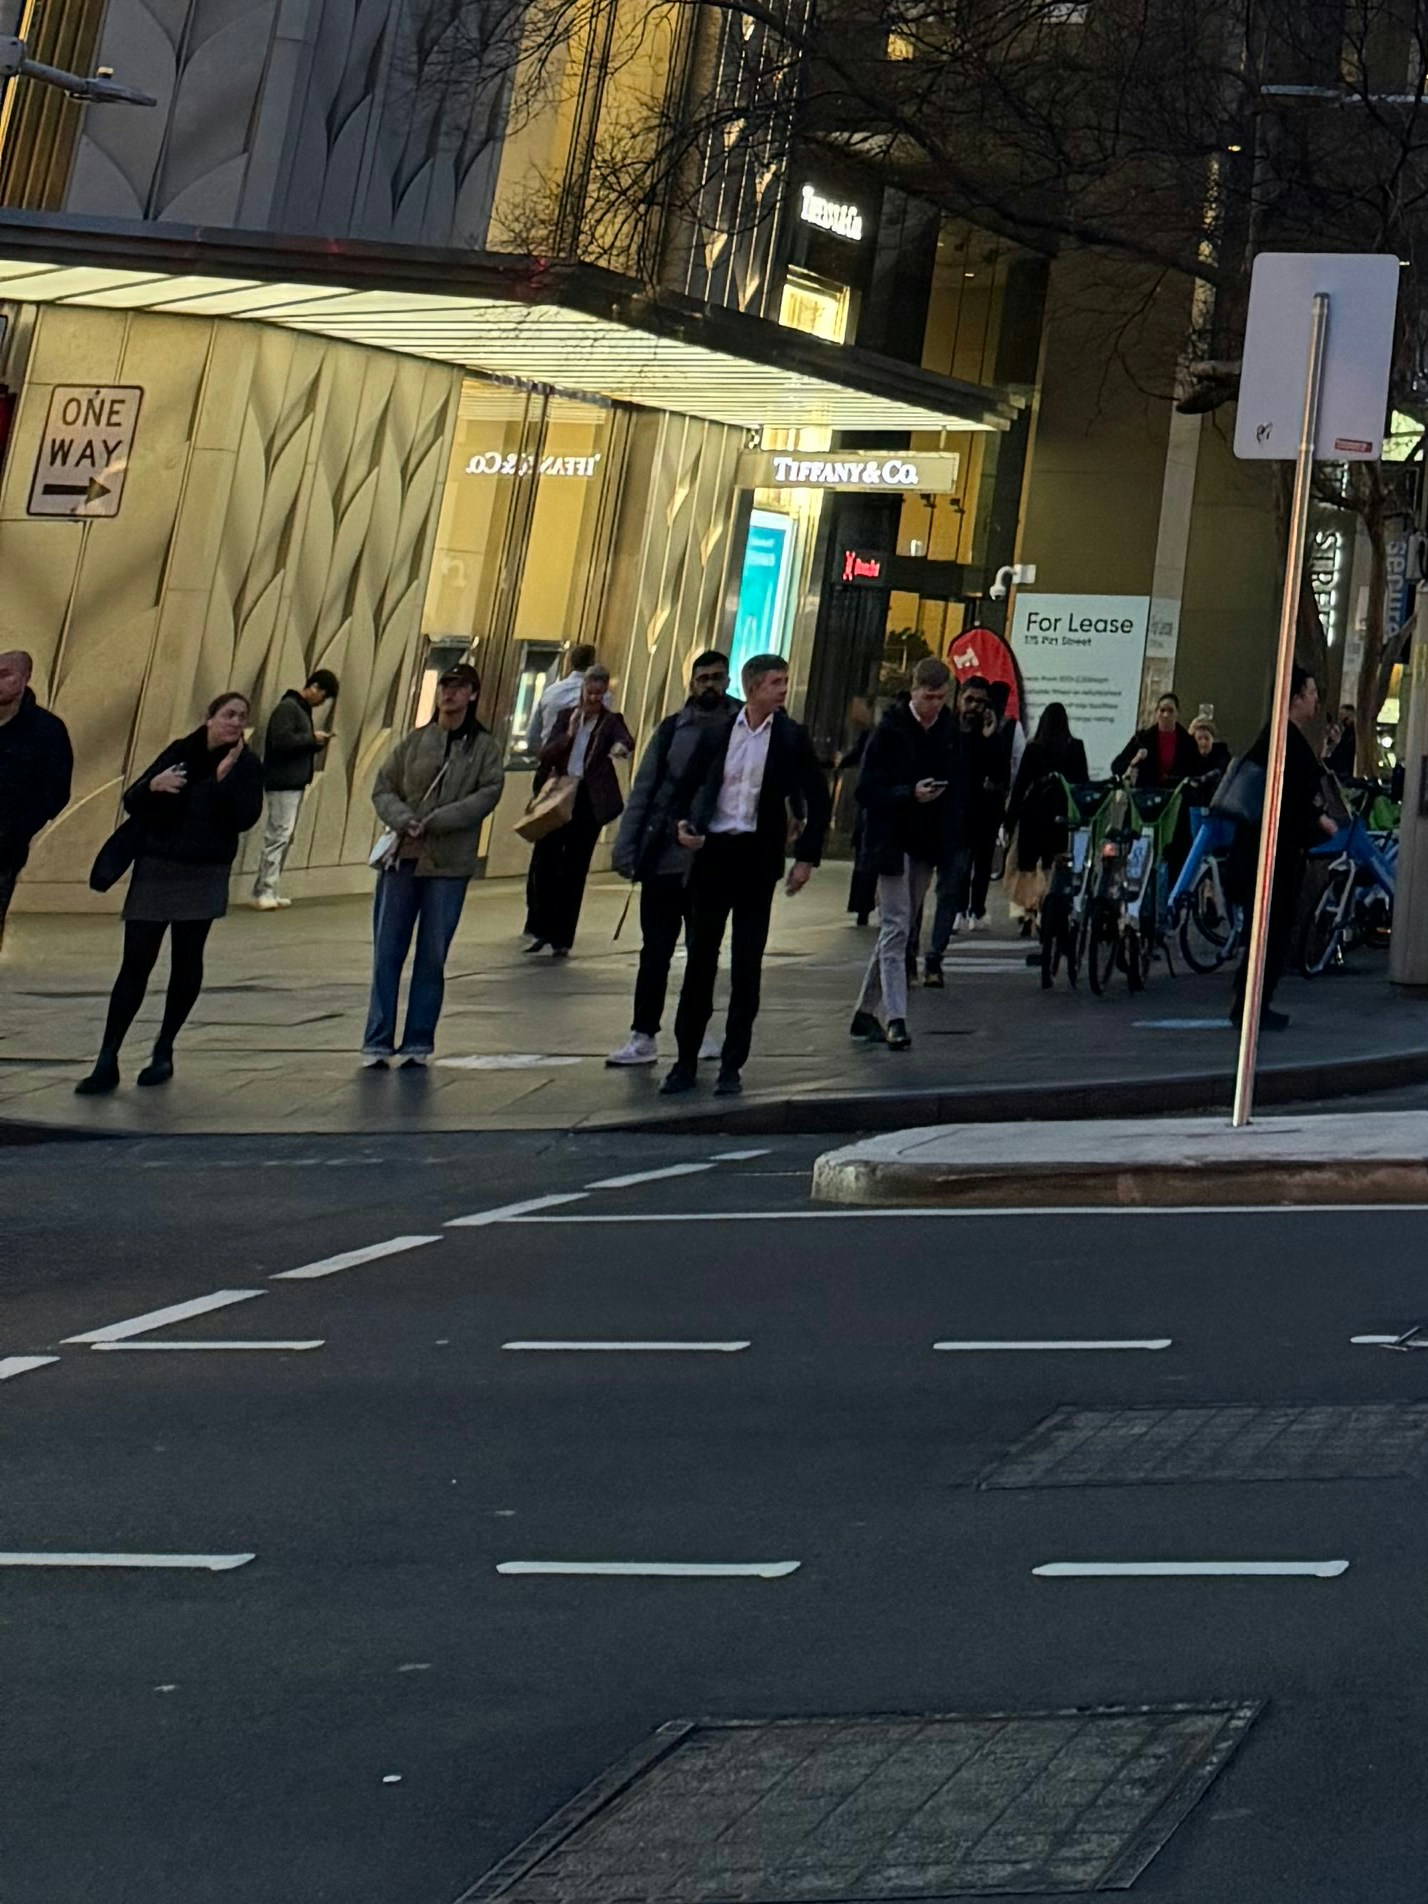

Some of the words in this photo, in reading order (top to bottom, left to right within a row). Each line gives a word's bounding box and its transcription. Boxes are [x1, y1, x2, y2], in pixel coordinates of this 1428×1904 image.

[62, 396, 126, 427] ONE
[49, 437, 123, 468] WAY
[1026, 611, 1063, 633] For
[1068, 612, 1134, 634] Lease
